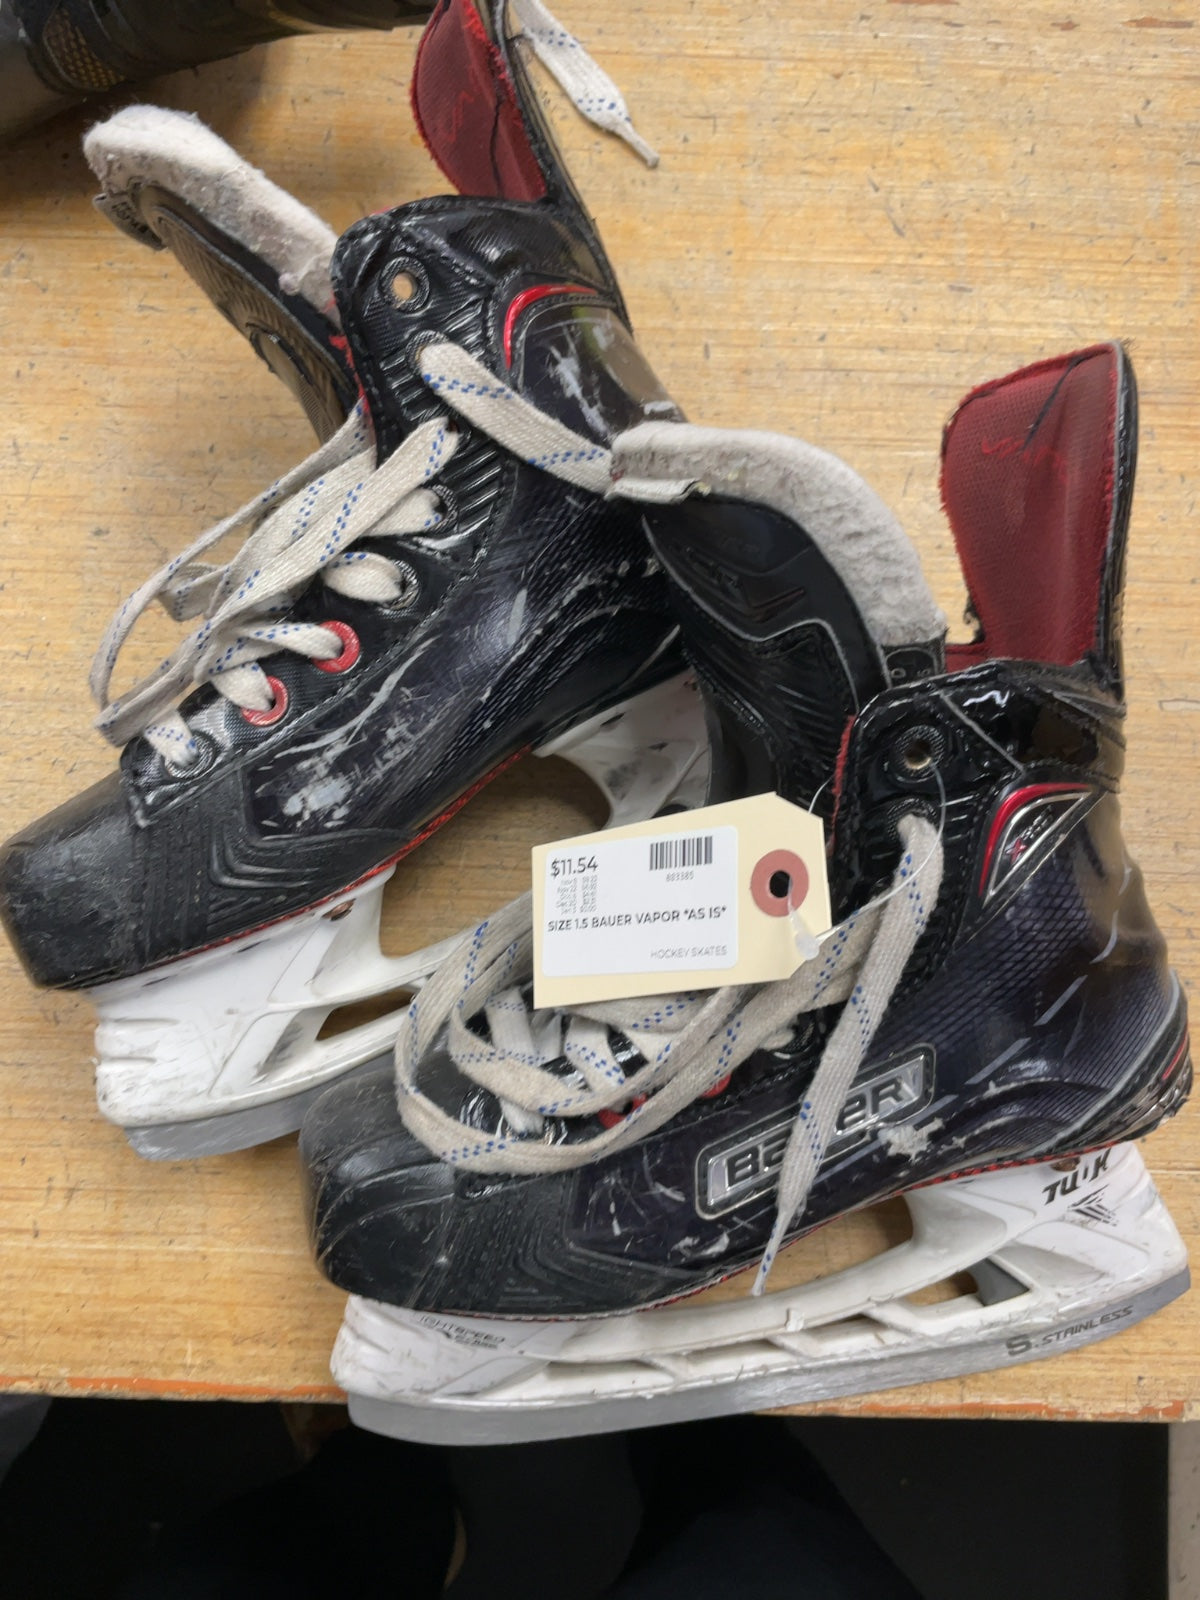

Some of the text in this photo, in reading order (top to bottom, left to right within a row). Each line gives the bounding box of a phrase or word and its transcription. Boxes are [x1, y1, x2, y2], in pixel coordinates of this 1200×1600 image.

[551, 855, 598, 878] $11.54
[547, 919, 572, 933] SIZE
[575, 917, 589, 930] 1.5
[591, 914, 632, 928] BAUER
[635, 909, 680, 925] VAPOR
[650, 944, 728, 960] HOCKEY SKATES
